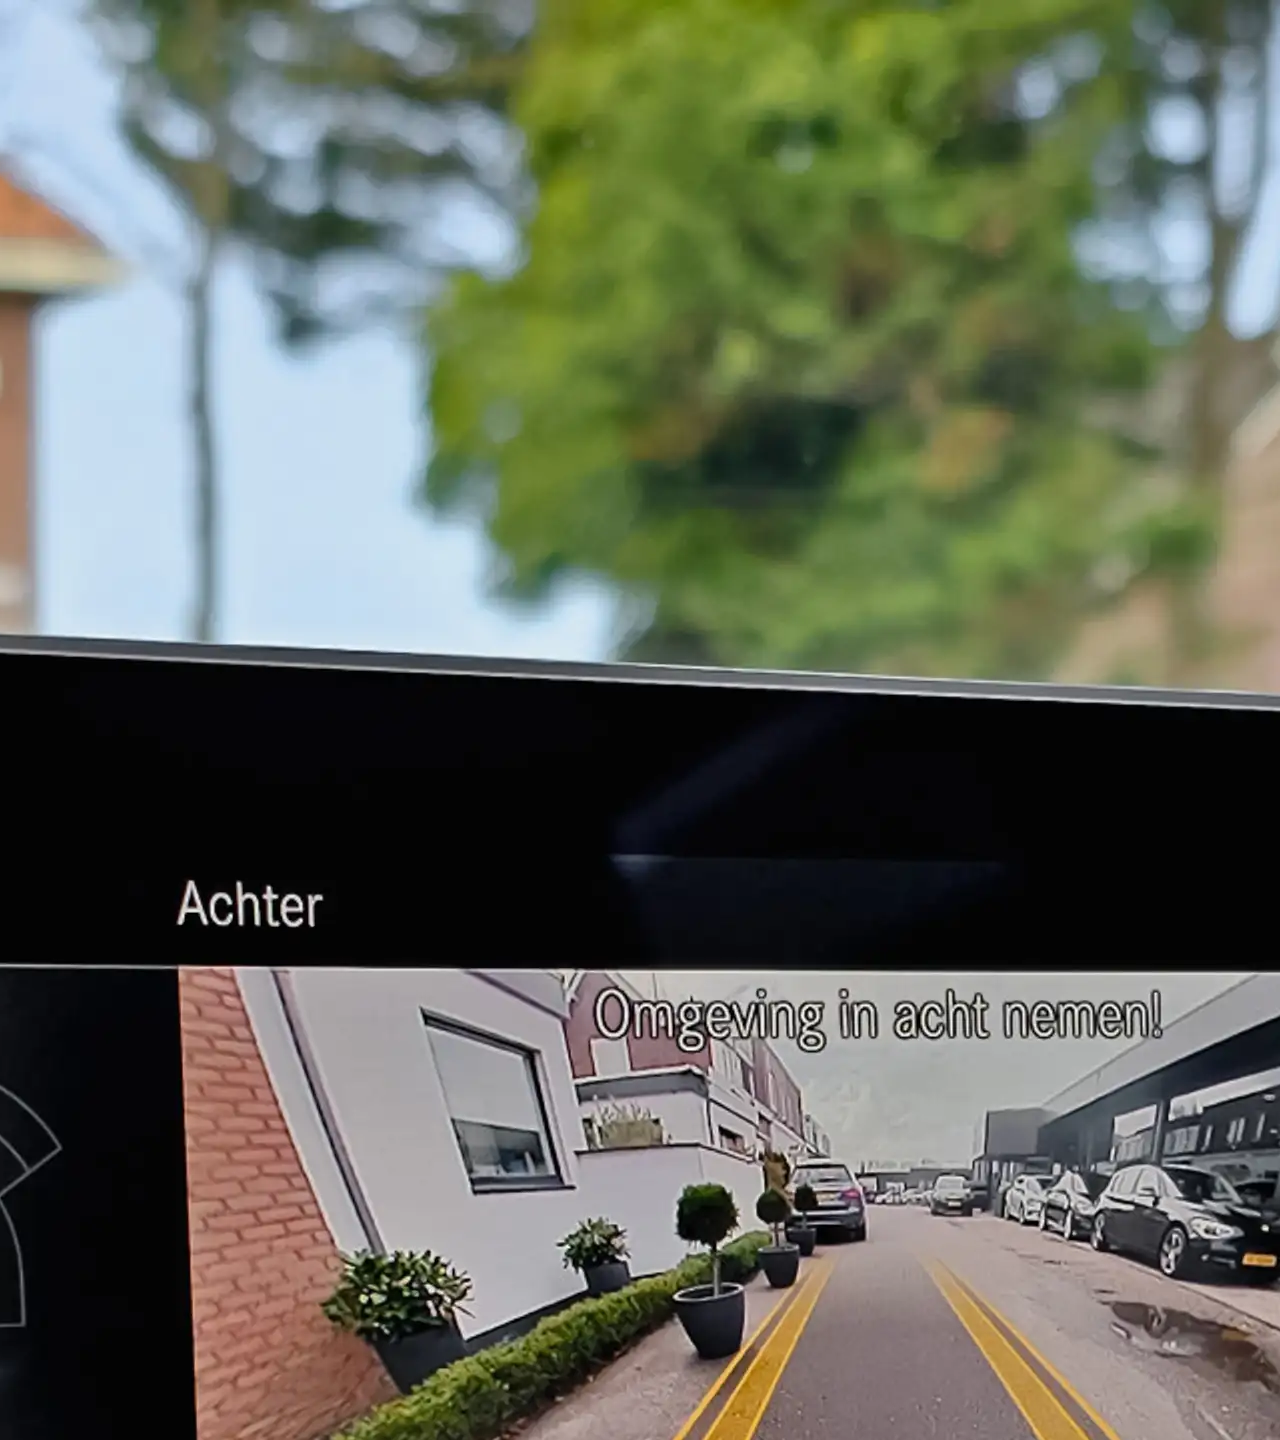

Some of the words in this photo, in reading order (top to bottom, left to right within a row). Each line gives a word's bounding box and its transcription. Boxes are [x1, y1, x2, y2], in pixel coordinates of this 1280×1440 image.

[176, 879, 324, 928] Achter
[594, 987, 827, 1053] Omgeving
[838, 987, 879, 1039] in
[893, 987, 991, 1040] acht
[1002, 989, 1164, 1040] nemen!
